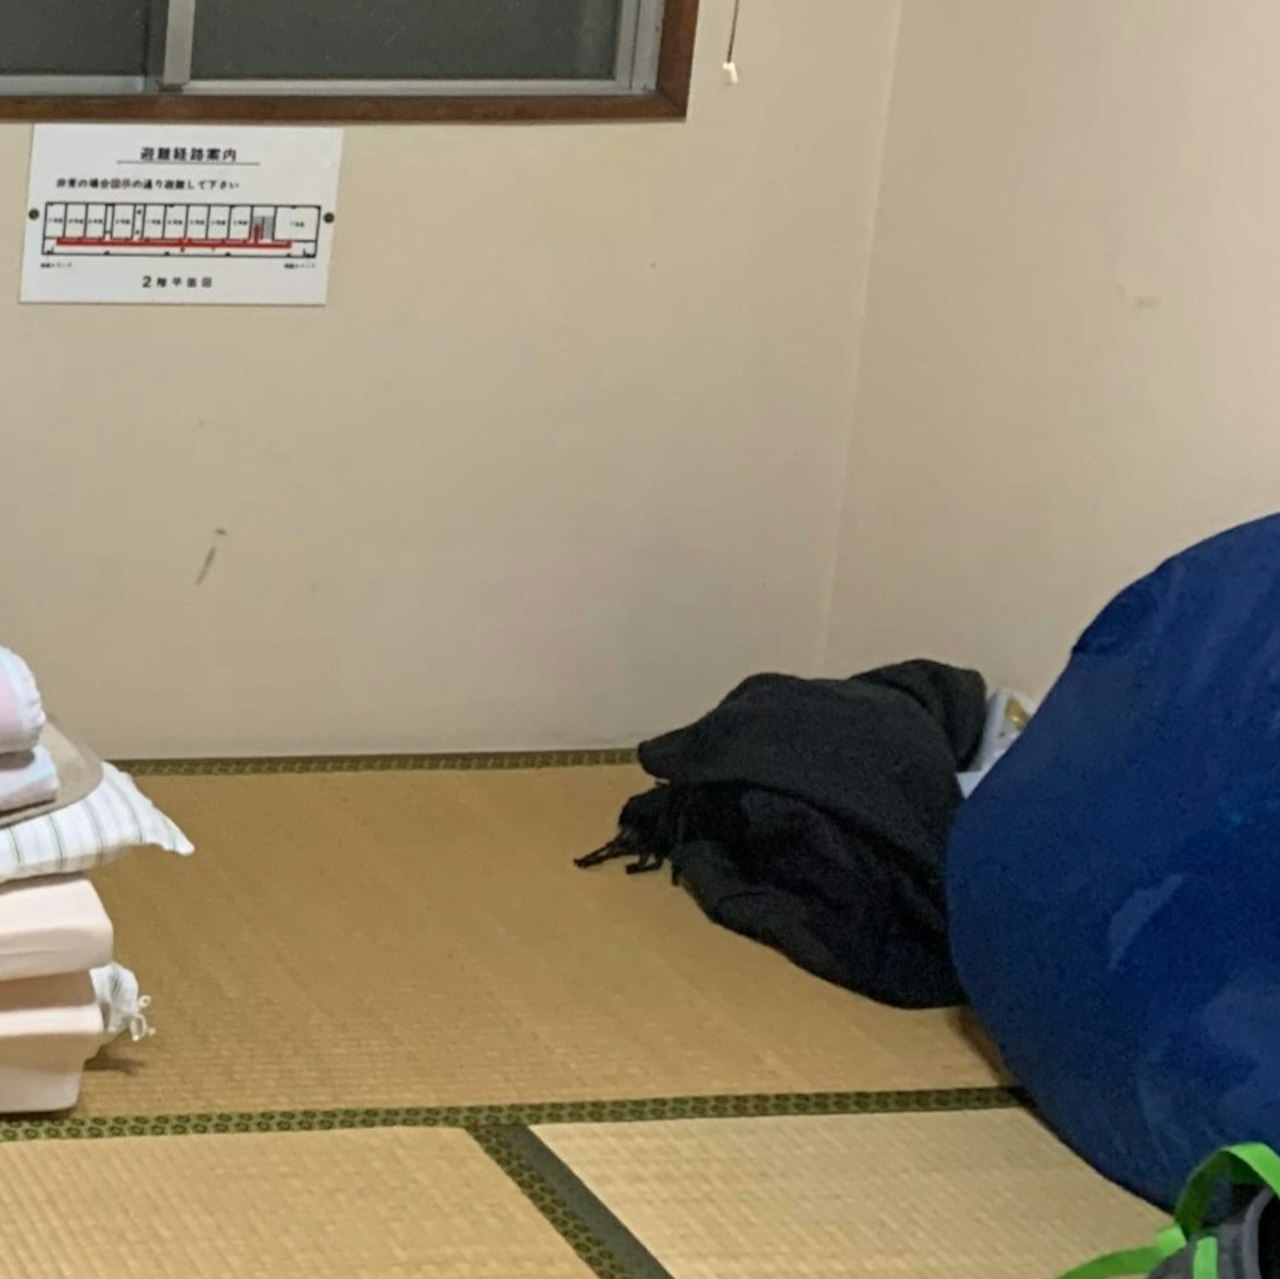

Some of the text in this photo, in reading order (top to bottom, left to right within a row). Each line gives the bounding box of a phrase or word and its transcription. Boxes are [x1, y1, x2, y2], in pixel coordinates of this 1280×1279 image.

[140, 147, 237, 162] 避難経路案内
